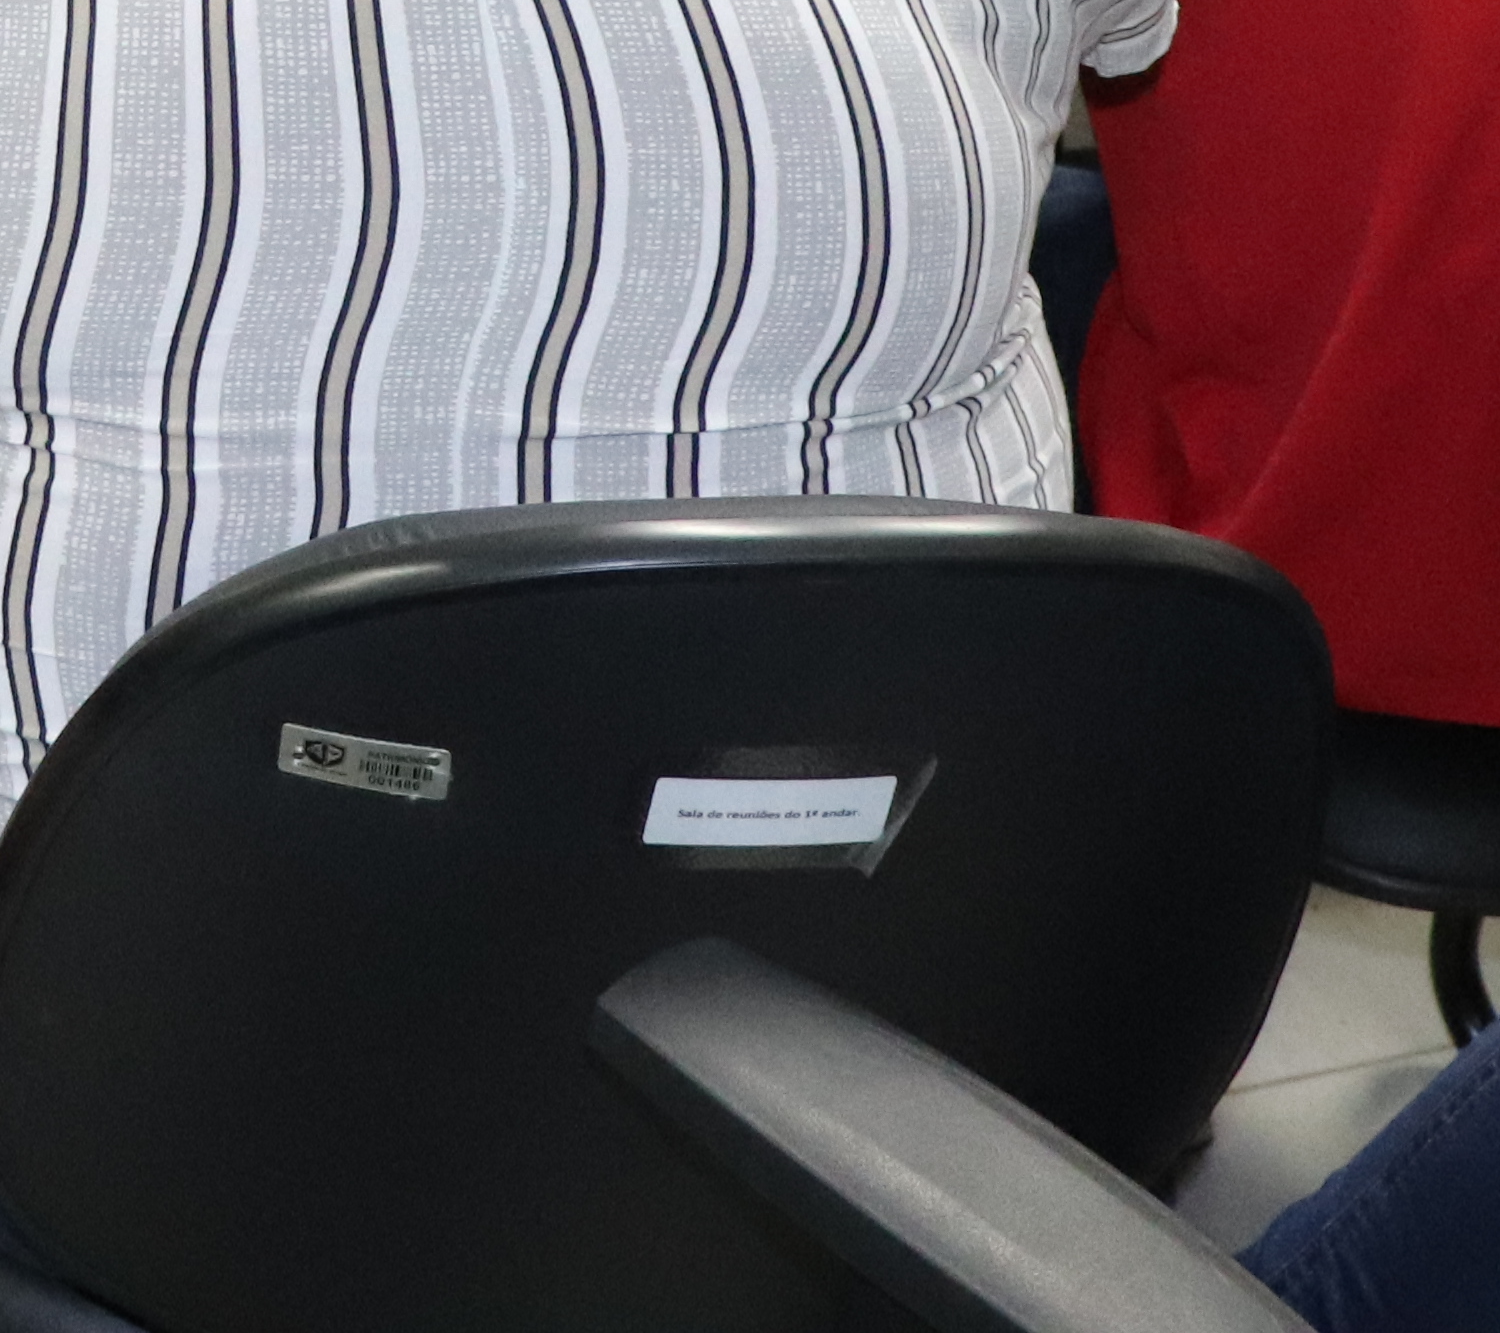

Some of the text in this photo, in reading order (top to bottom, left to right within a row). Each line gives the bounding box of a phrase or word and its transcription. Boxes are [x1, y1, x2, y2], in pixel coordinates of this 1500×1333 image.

[677, 808, 703, 819] Sala
[707, 809, 723, 819] de
[726, 809, 781, 819] reuniões
[784, 810, 801, 819] do
